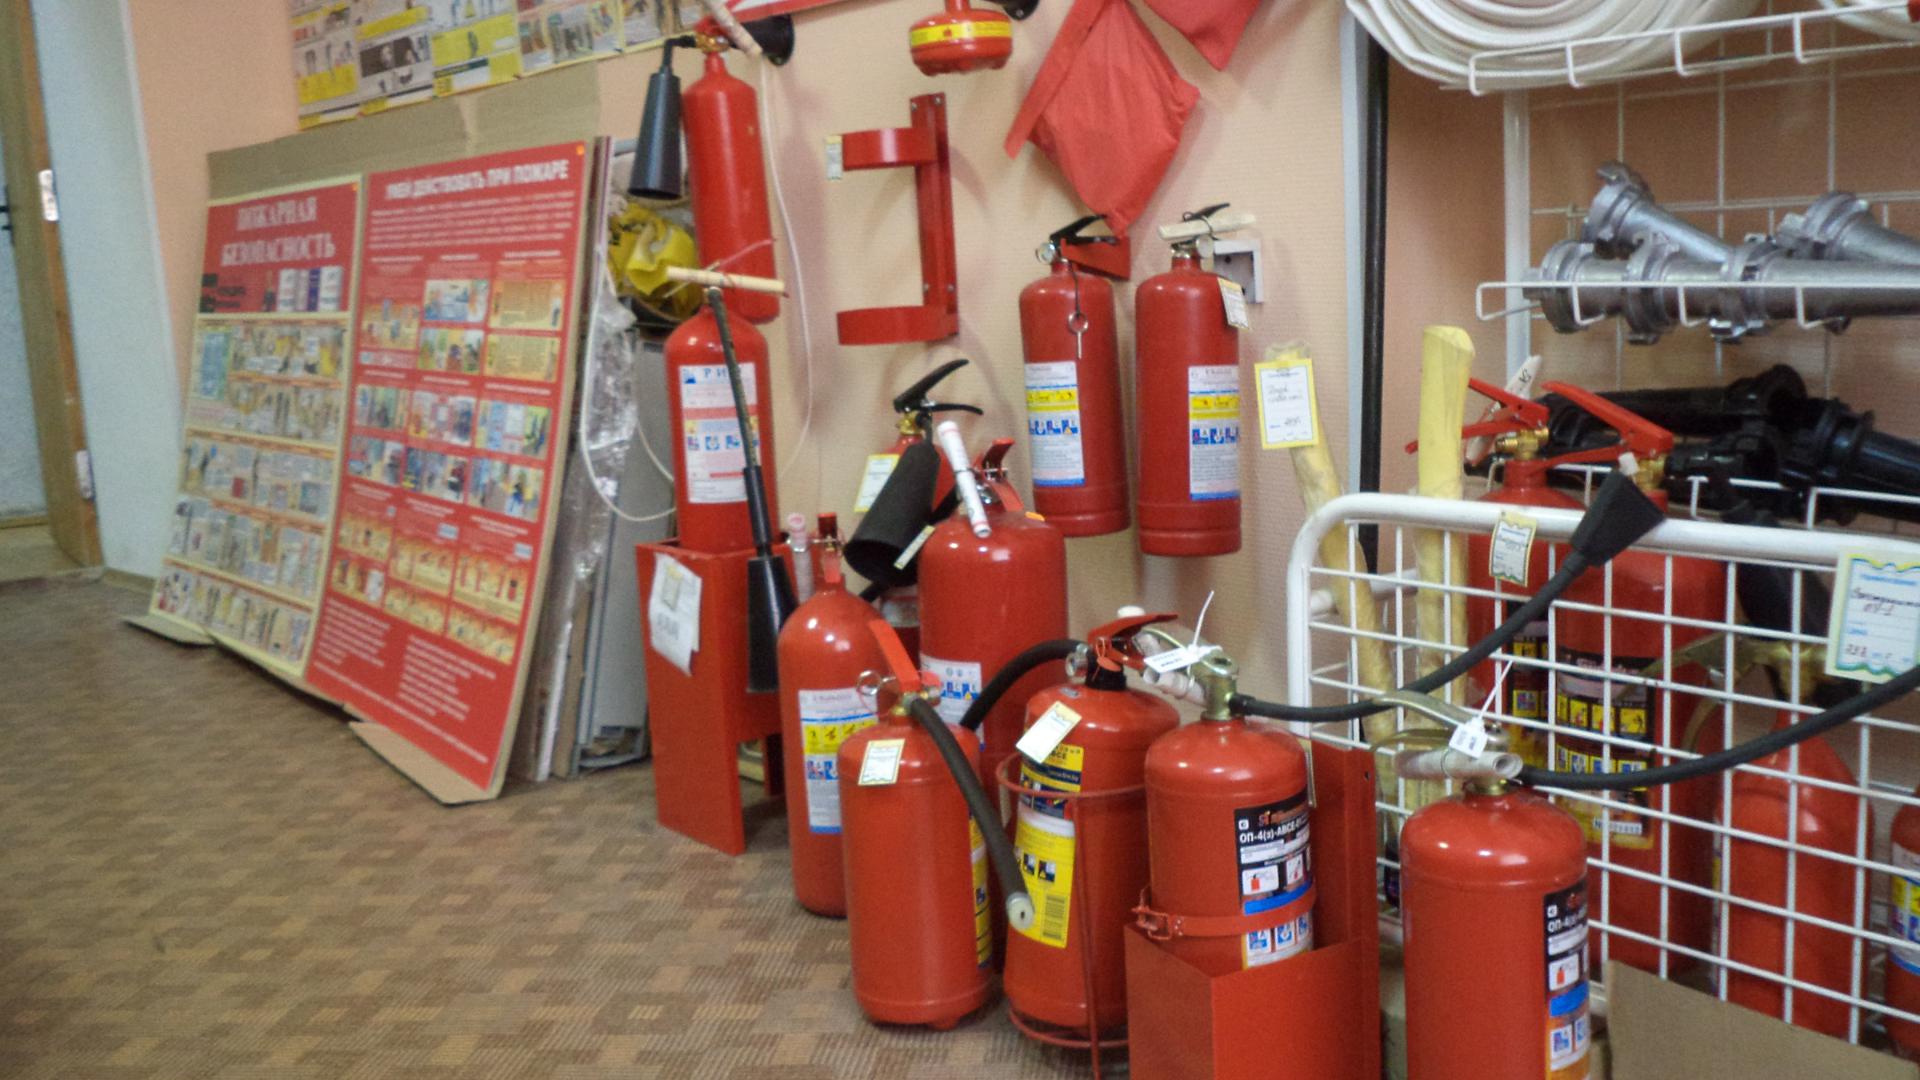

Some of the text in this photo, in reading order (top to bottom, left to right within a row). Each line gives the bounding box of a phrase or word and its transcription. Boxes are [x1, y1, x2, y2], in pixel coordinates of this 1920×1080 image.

[413, 171, 485, 197] ДЕЙСТВОВАТЬ
[486, 167, 511, 188] ПРИ
[512, 159, 570, 185] ПОЖАРЕ
[236, 196, 318, 231] ПОЖАРНАЯ
[220, 232, 336, 268] БЕЗОПАСНОСТЬ
